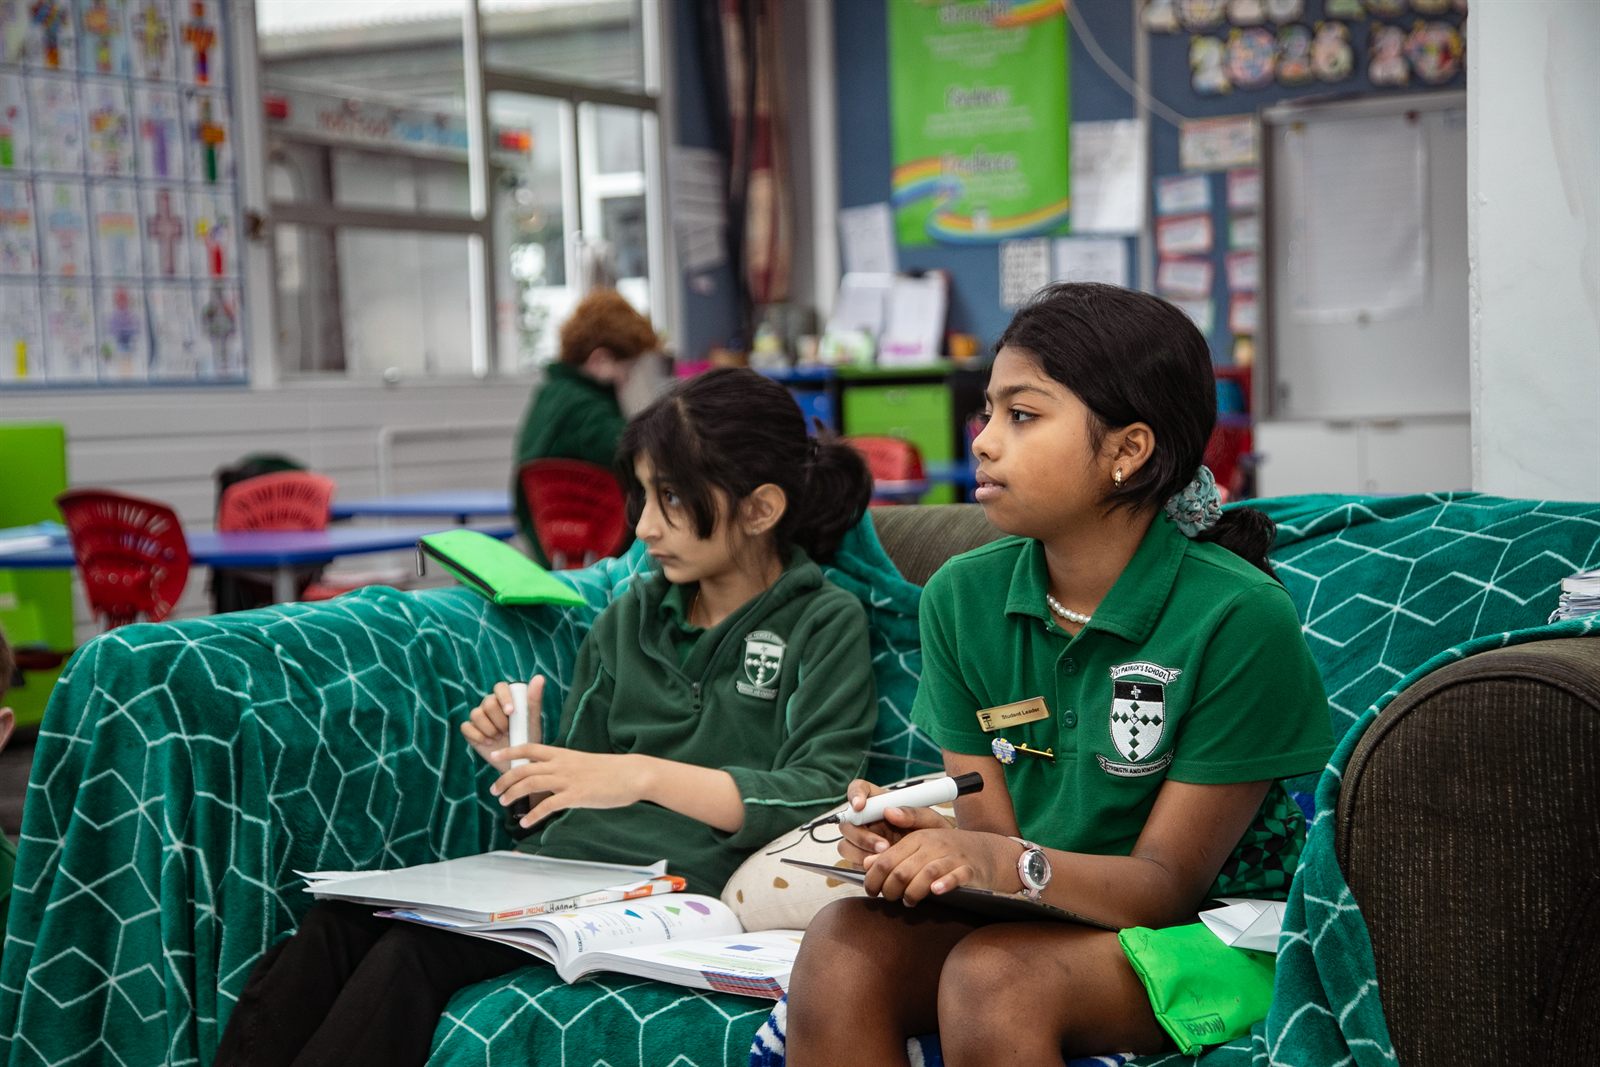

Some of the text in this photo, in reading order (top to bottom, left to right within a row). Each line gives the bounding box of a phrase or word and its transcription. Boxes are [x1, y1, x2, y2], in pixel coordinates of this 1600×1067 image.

[1121, 664, 1144, 673] PATRICK'S
[1145, 665, 1167, 680] SCHOOL
[1001, 707, 1040, 720] Student Leader
